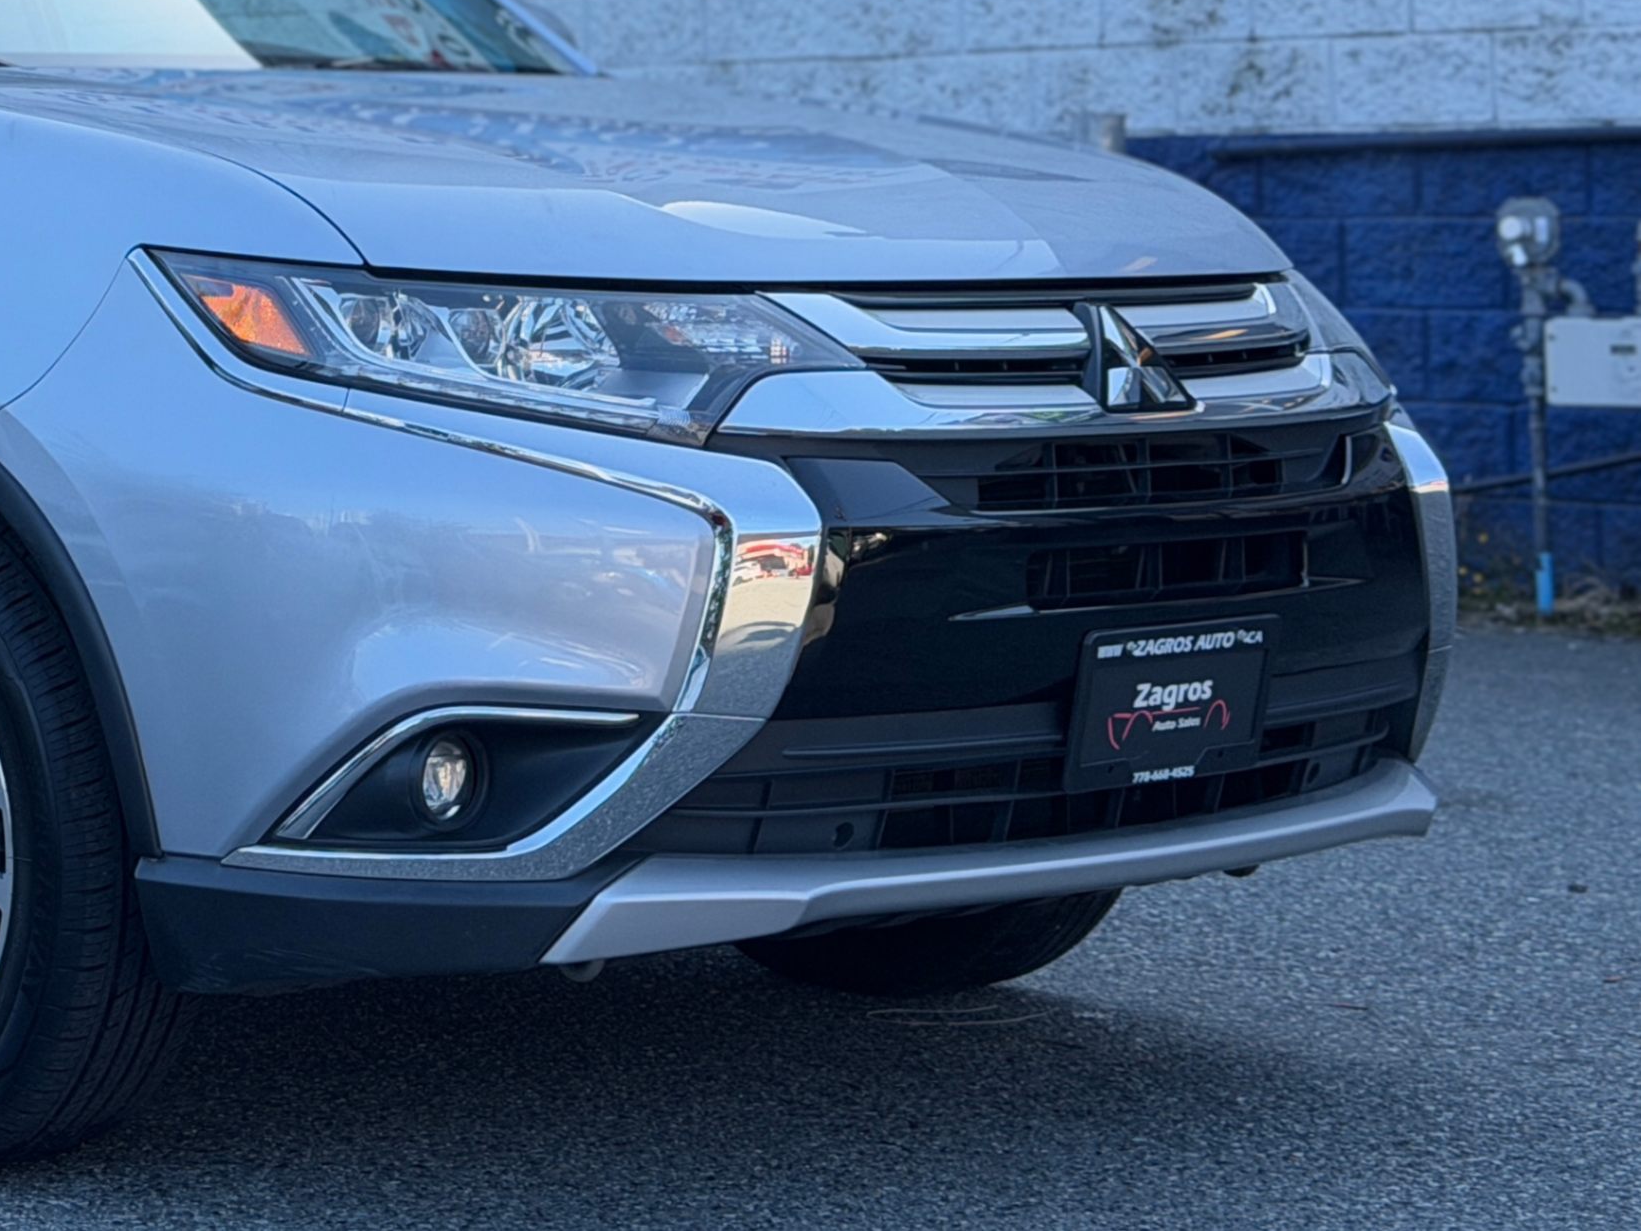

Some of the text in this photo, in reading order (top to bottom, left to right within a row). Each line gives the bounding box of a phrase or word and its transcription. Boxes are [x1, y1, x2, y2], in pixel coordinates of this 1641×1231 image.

[1132, 639, 1194, 656] ZAGROS
[1194, 631, 1235, 651] AUTO
[1133, 680, 1213, 711] Zagros
